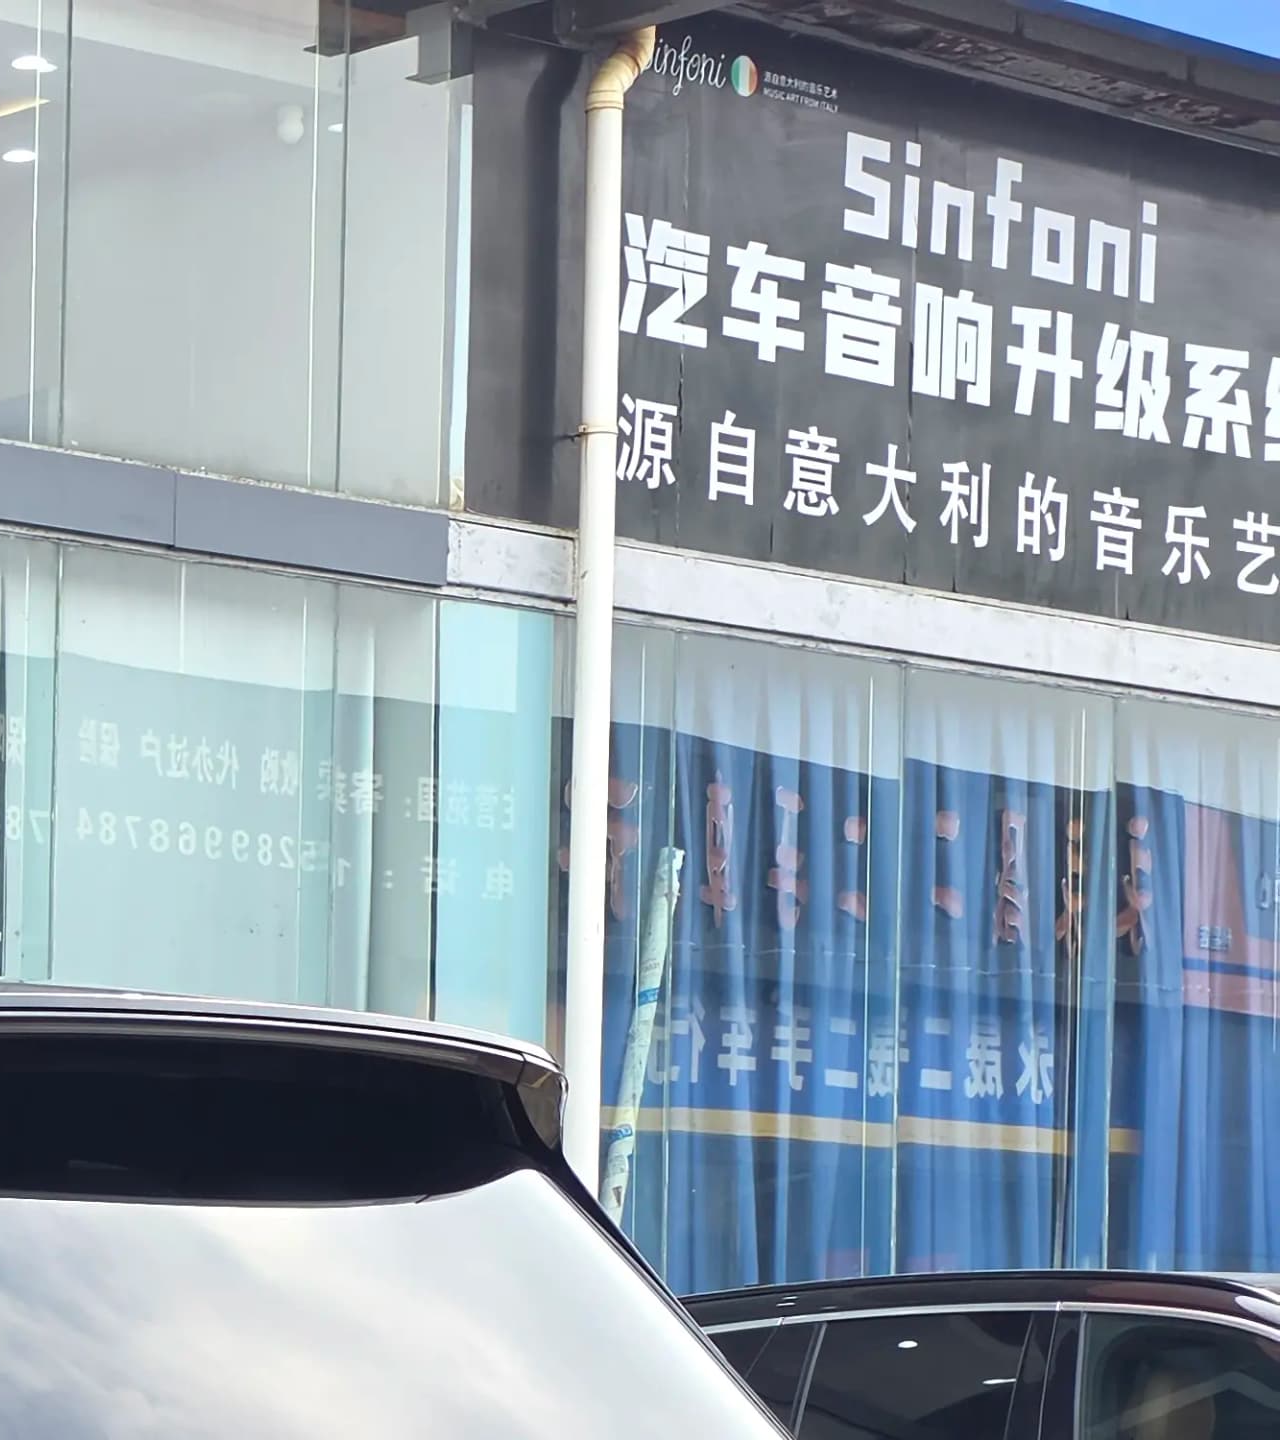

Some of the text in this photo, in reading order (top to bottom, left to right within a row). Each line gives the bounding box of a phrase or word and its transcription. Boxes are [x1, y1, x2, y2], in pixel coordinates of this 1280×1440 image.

[646, 34, 727, 97] infoni
[843, 131, 1158, 304] Sinfoni
[619, 211, 1280, 461] 汽车音响升级系
